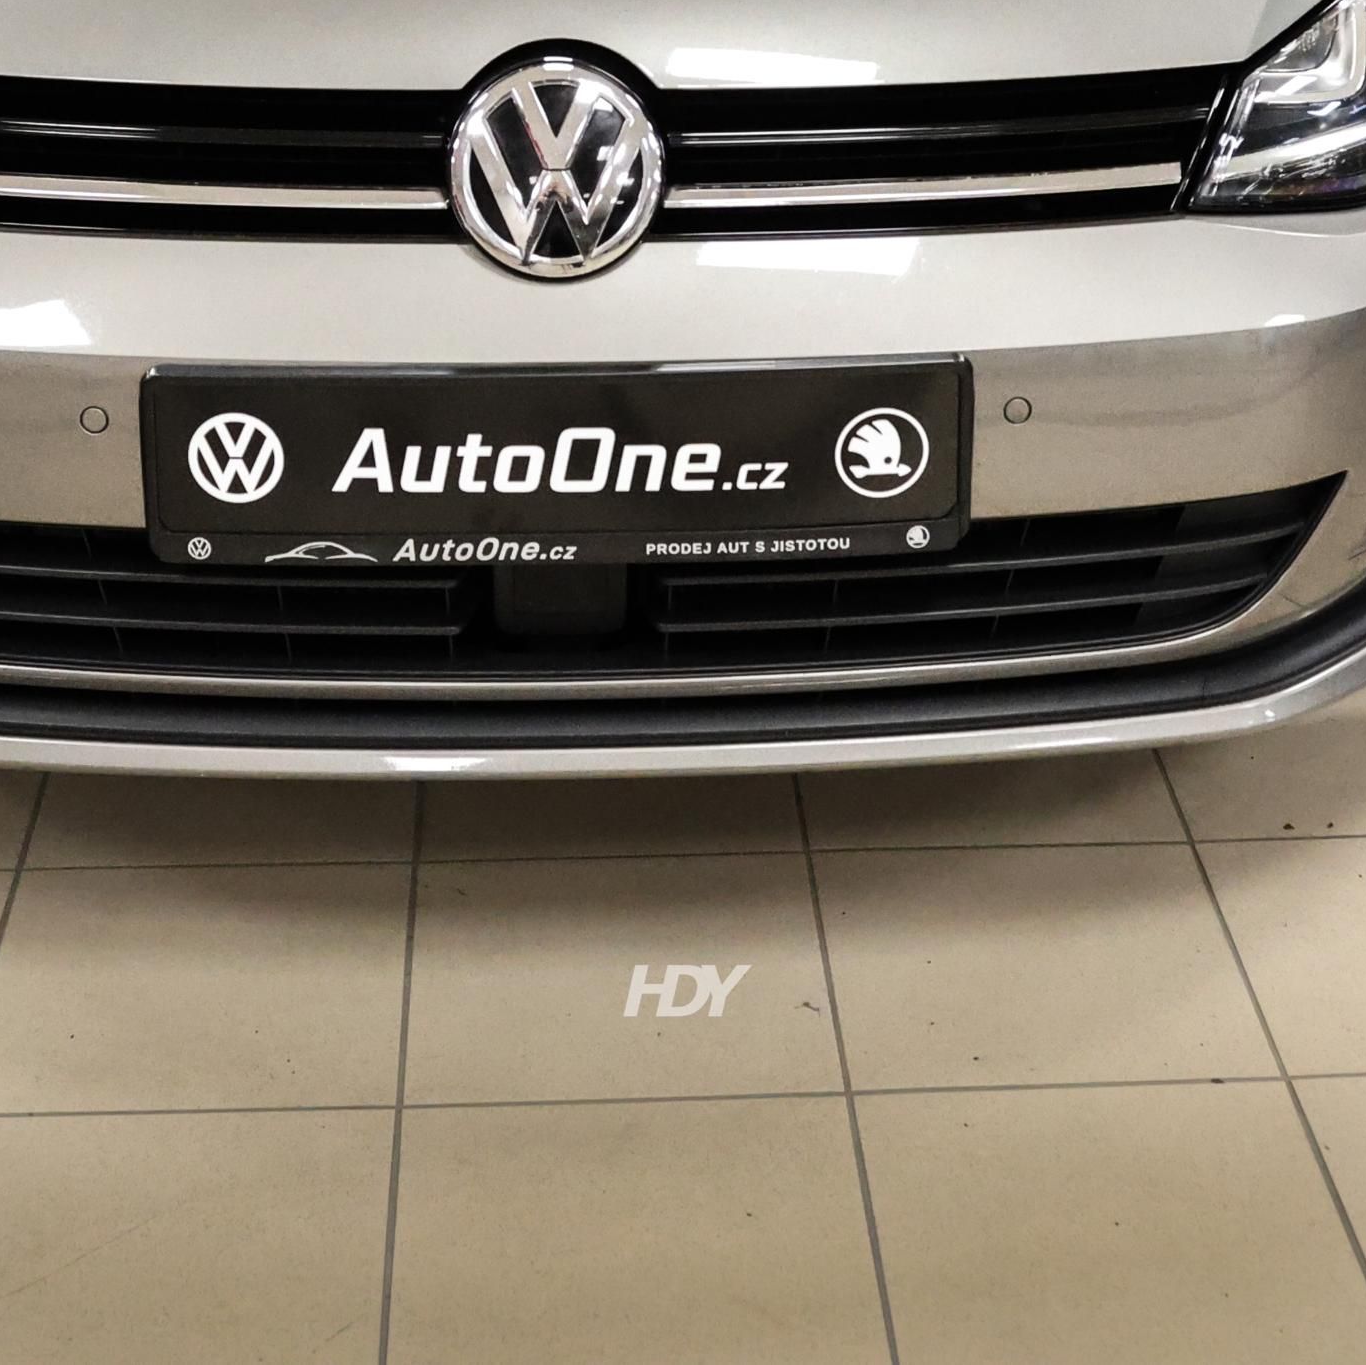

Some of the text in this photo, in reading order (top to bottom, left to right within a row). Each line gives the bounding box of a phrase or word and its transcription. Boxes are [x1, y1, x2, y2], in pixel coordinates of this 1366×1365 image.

[331, 426, 789, 493] AutoOne.cz
[392, 537, 578, 562] AutoOne.cz
[645, 537, 851, 556] PRODEJ AUT S JISTOTOU
